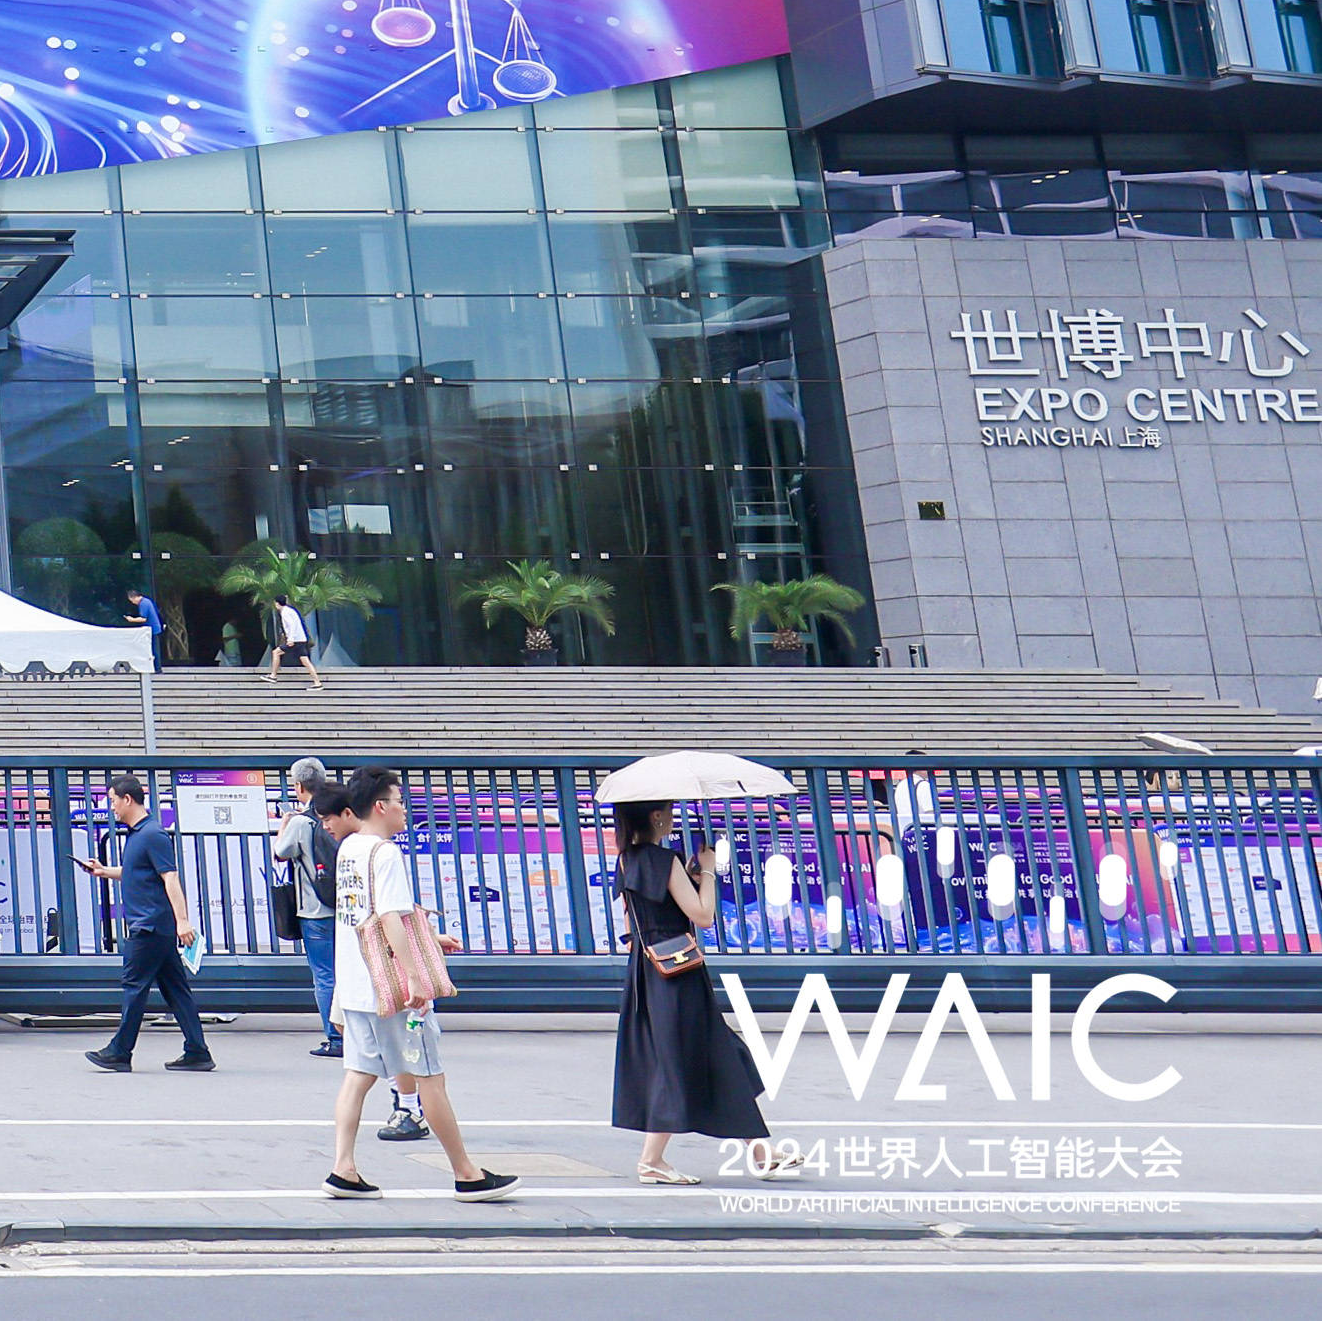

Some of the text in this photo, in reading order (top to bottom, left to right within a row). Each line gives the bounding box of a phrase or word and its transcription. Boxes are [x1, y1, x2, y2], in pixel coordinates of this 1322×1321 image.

[950, 308, 1311, 380] 世博中心
[974, 387, 1322, 423] EXPO CENTRE
[981, 426, 1163, 449] SHANGHAI 上海
[969, 842, 997, 852] WAC
